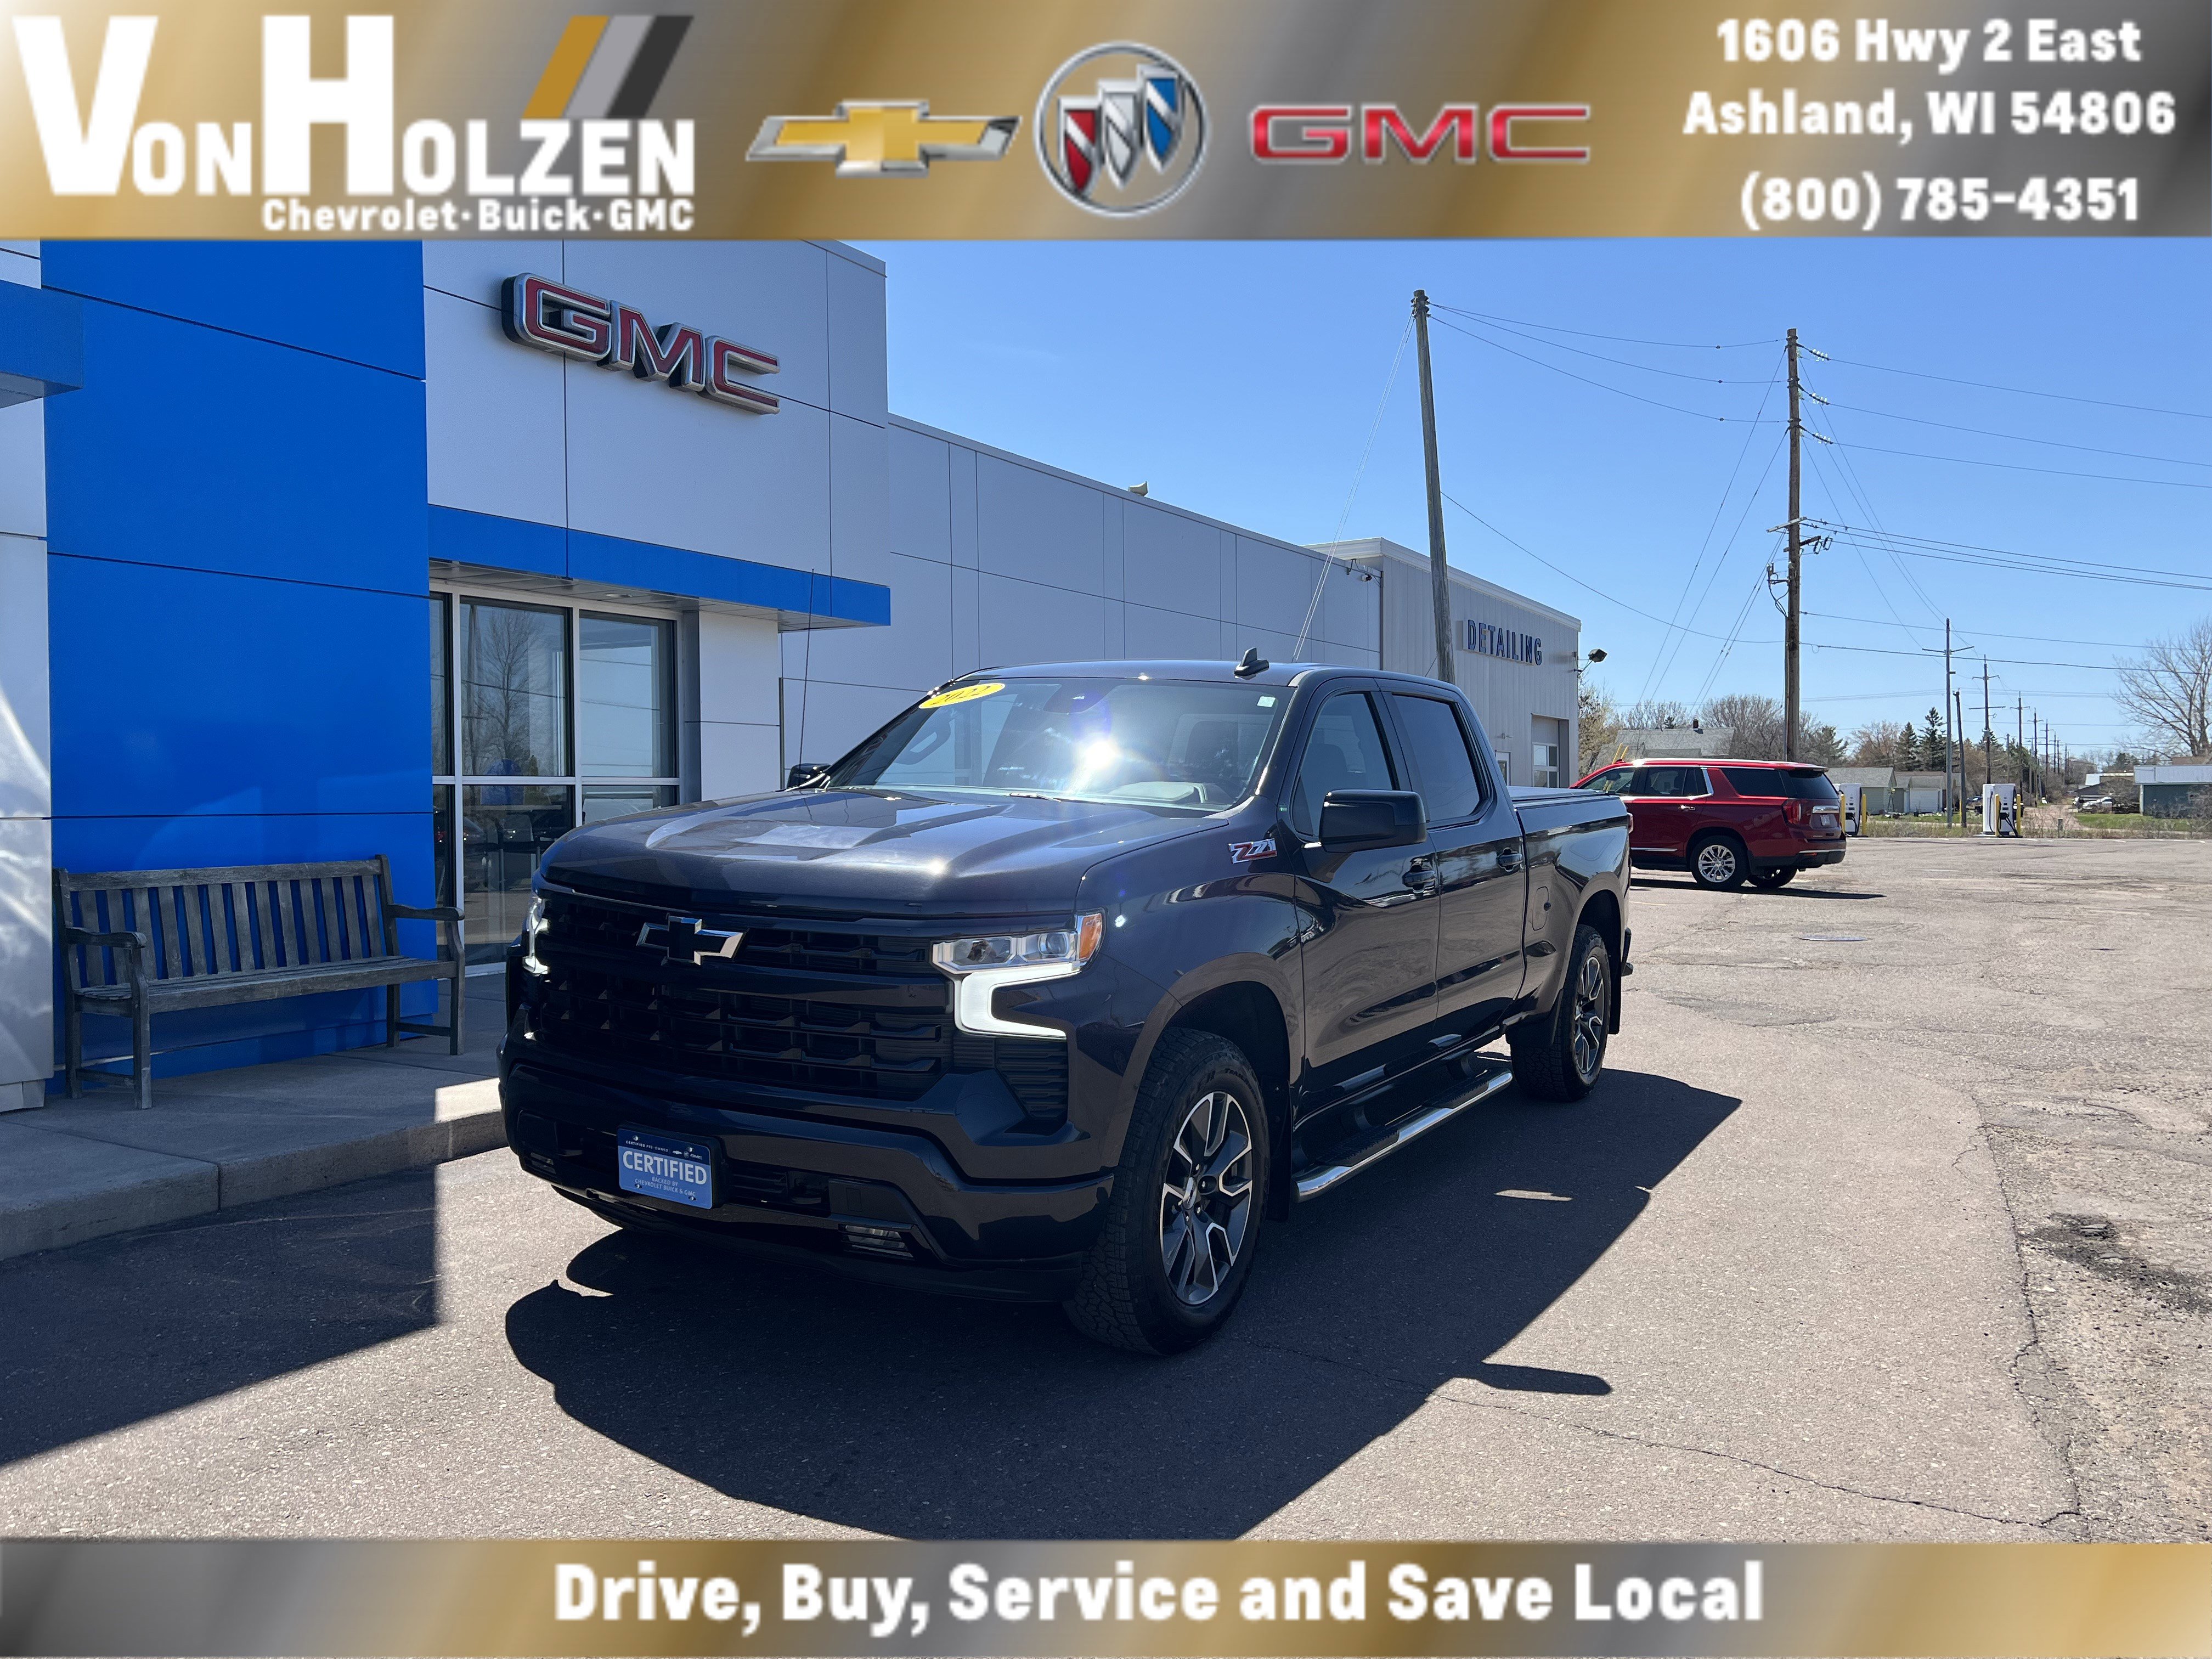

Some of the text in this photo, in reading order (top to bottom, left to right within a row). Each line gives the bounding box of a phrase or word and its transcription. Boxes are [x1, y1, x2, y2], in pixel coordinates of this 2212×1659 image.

[503, 272, 781, 415] GMC
[1468, 619, 1542, 666] DETAILING
[1228, 838, 1278, 864] Z71
[623, 1150, 707, 1185] CERTIFIED
[651, 1176, 671, 1184] BACKED
[635, 1178, 662, 1189] CHEVROLET
[663, 1184, 679, 1193] BUICK
